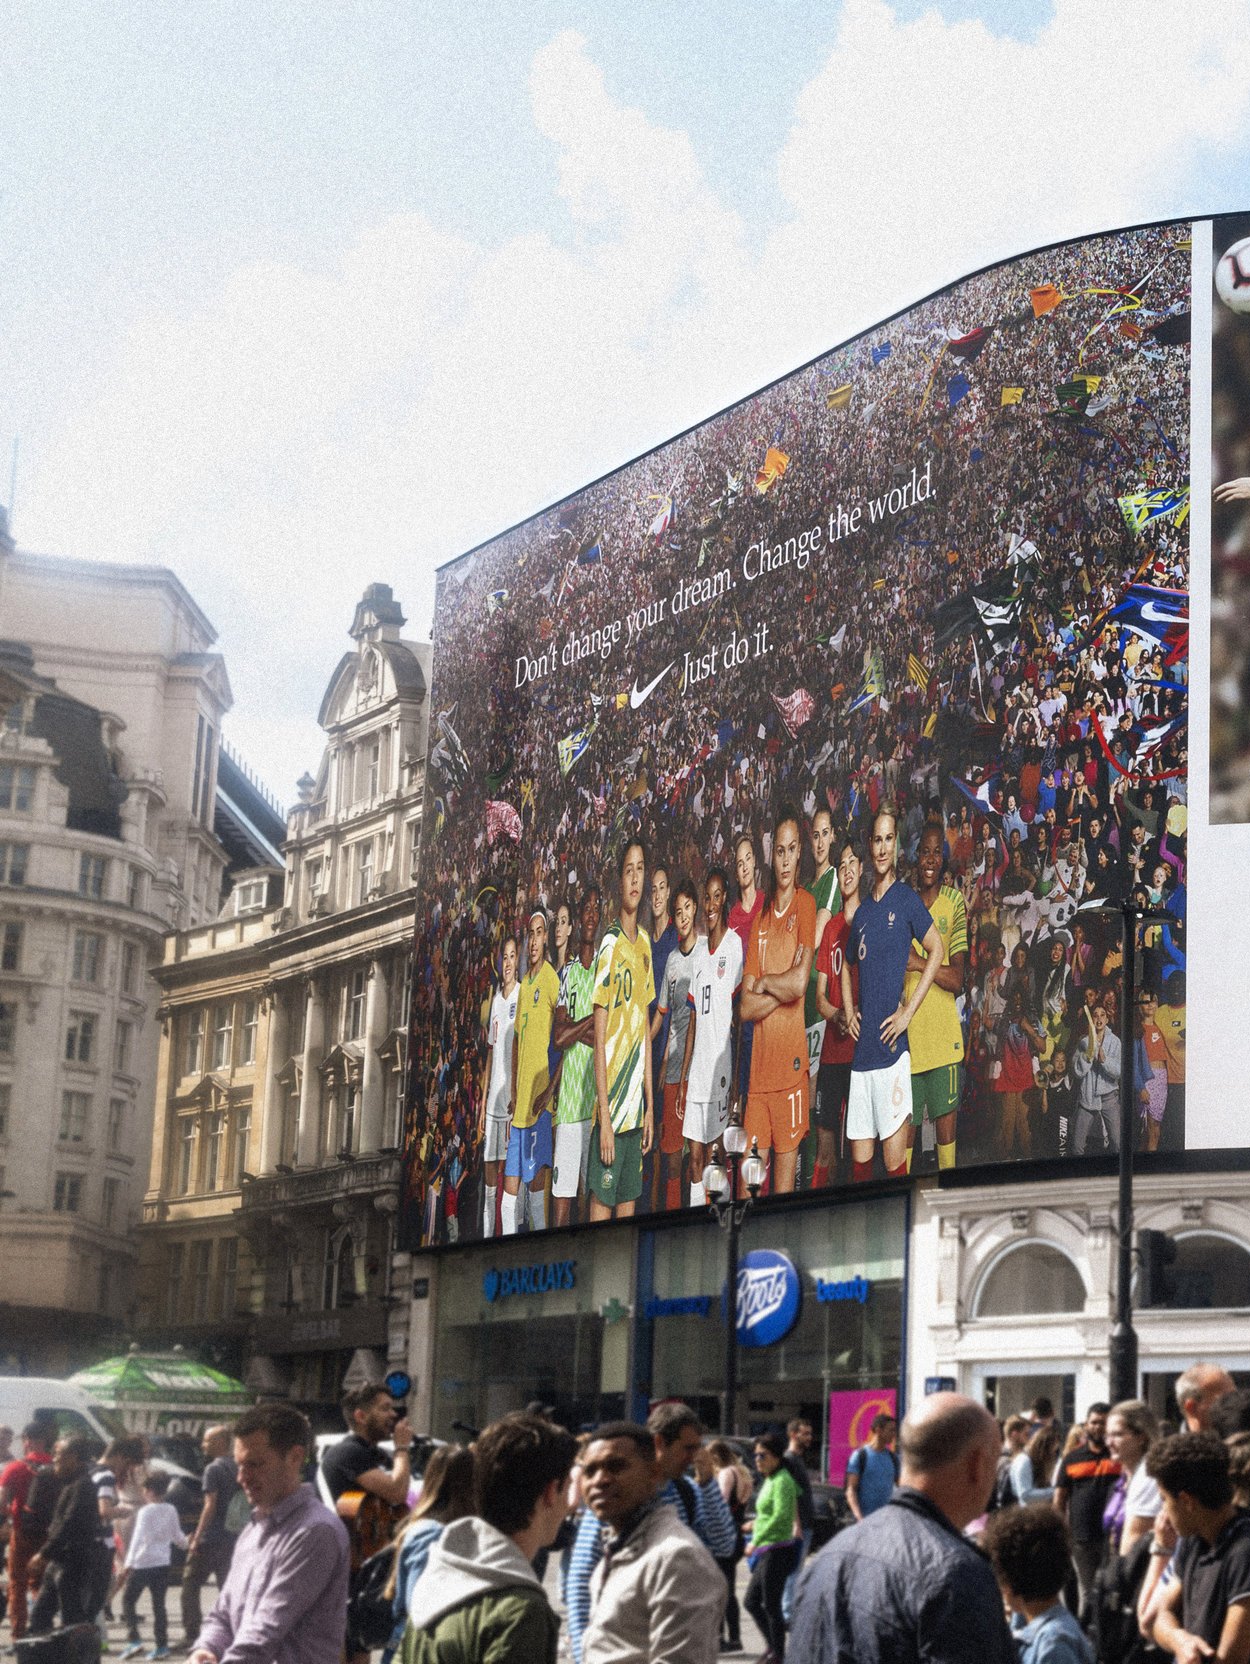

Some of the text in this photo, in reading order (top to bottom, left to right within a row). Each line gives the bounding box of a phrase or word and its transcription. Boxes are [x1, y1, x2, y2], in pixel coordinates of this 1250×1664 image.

[515, 461, 937, 688] Don't change your dream. Change the world.
[681, 622, 774, 697] Just do it.
[830, 948, 843, 976] 10
[858, 934, 867, 961] 6
[614, 968, 632, 1009] 20
[702, 984, 711, 1015] 19
[521, 1013, 528, 1042] 7
[806, 1030, 821, 1058] 12
[891, 1075, 905, 1106] 6
[948, 1064, 958, 1094] 11
[787, 1089, 802, 1128] 11
[531, 1131, 538, 1160] 7
[500, 1259, 577, 1296] BARCLAYS
[736, 1264, 788, 1329] Boots
